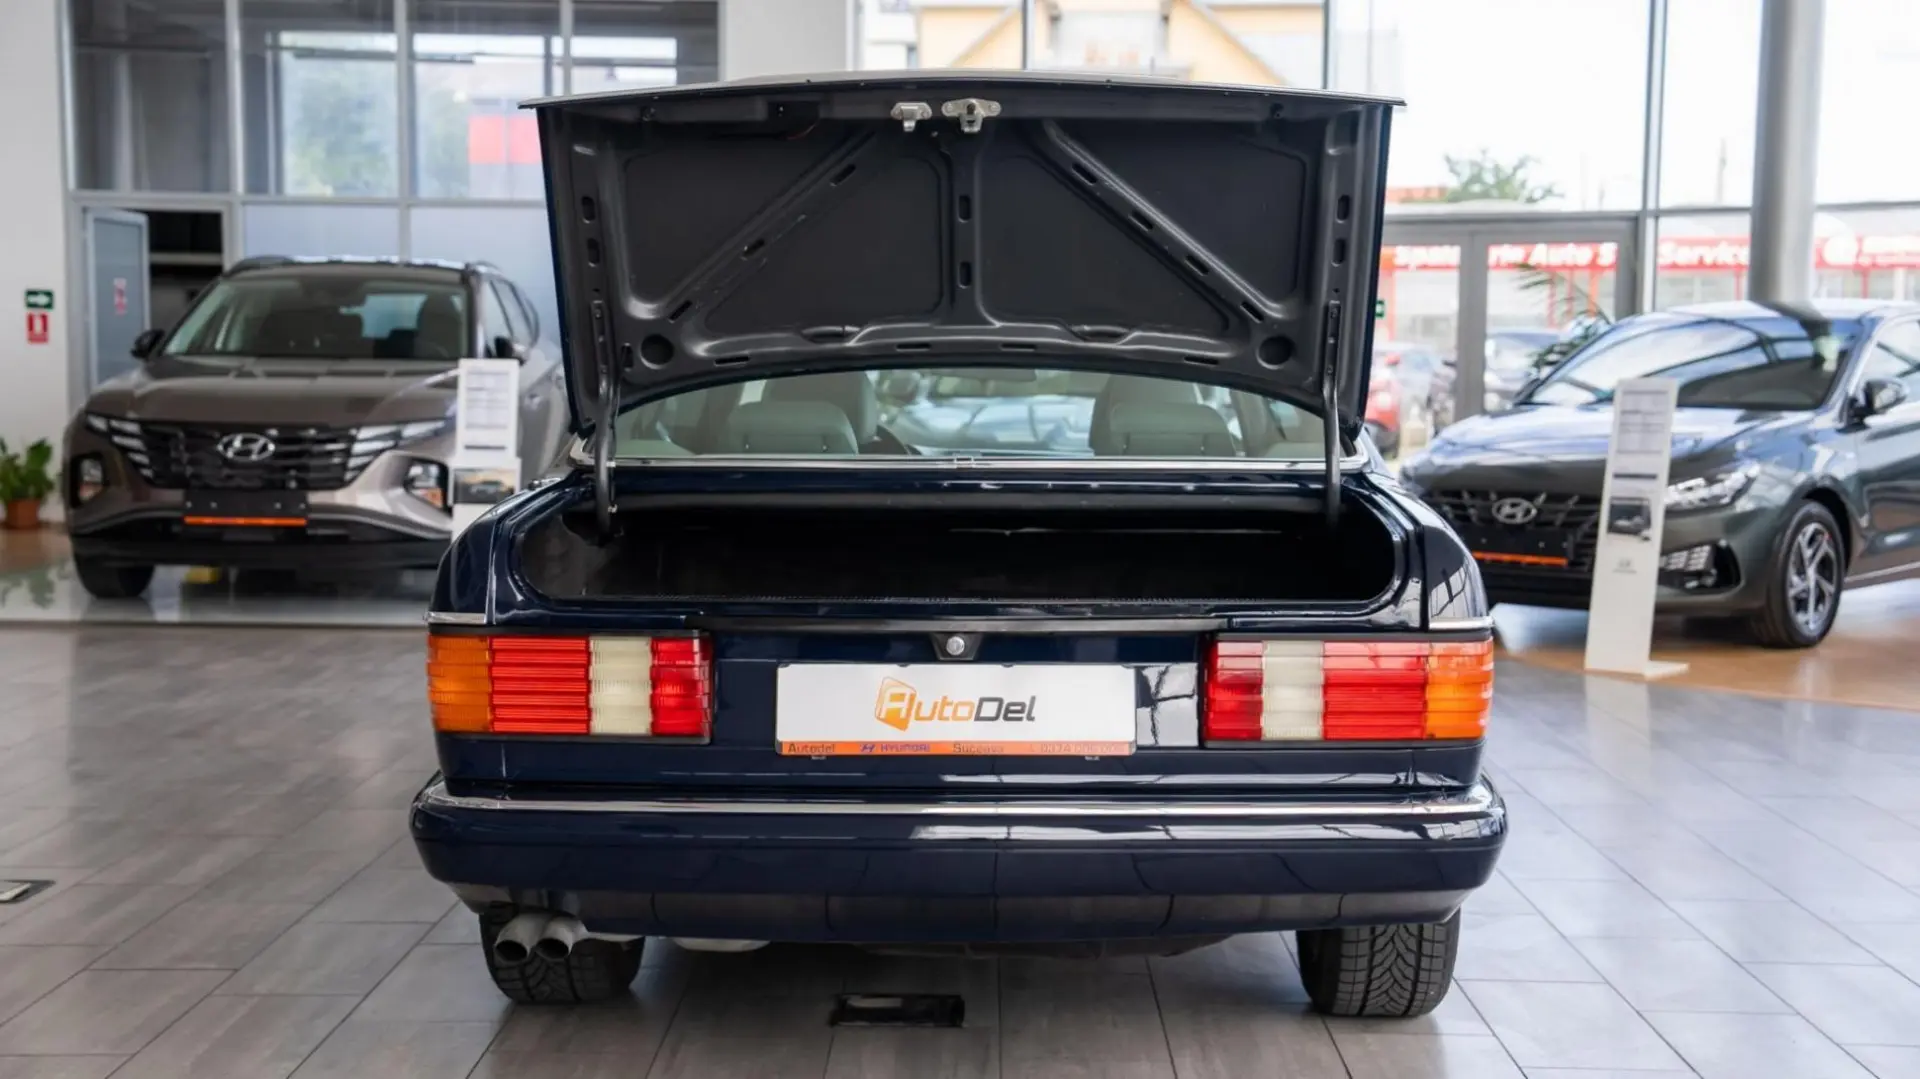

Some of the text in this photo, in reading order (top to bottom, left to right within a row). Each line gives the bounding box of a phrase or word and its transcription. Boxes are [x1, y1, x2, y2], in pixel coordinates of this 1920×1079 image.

[1529, 243, 1593, 266] Auto
[877, 683, 1037, 725] AutoDel
[787, 742, 836, 754] Autodel
